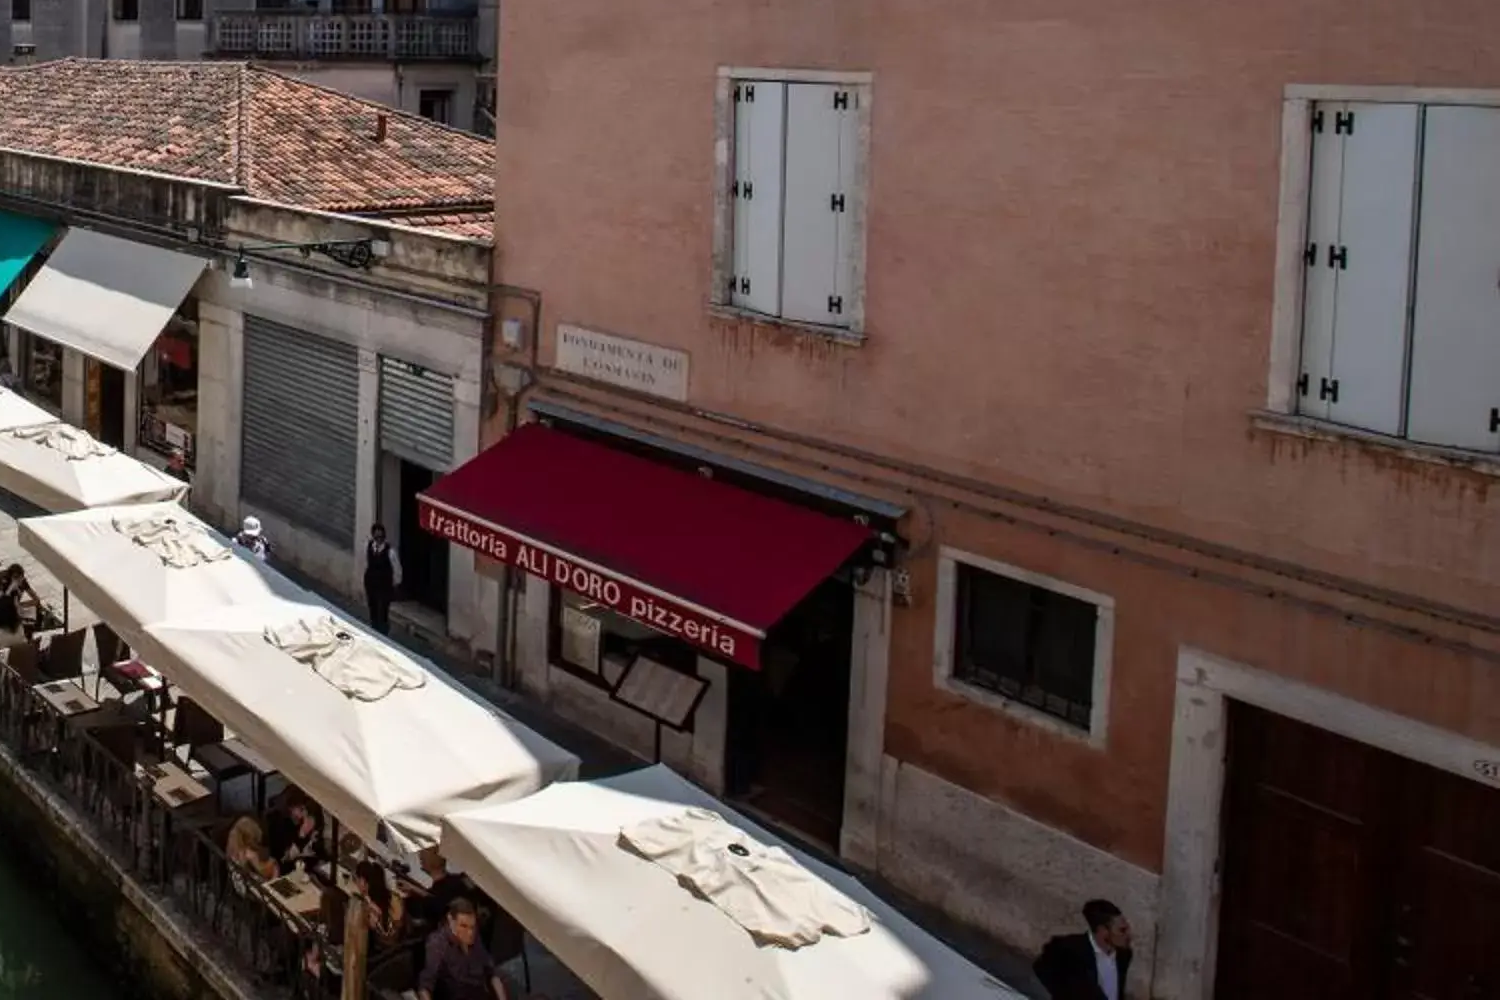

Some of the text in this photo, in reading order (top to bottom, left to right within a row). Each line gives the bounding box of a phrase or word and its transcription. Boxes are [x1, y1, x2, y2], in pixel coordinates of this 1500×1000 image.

[428, 506, 507, 560] trattoria
[515, 543, 549, 580] ALI
[555, 559, 622, 606] D'ORO
[630, 595, 737, 658] pizzeria
